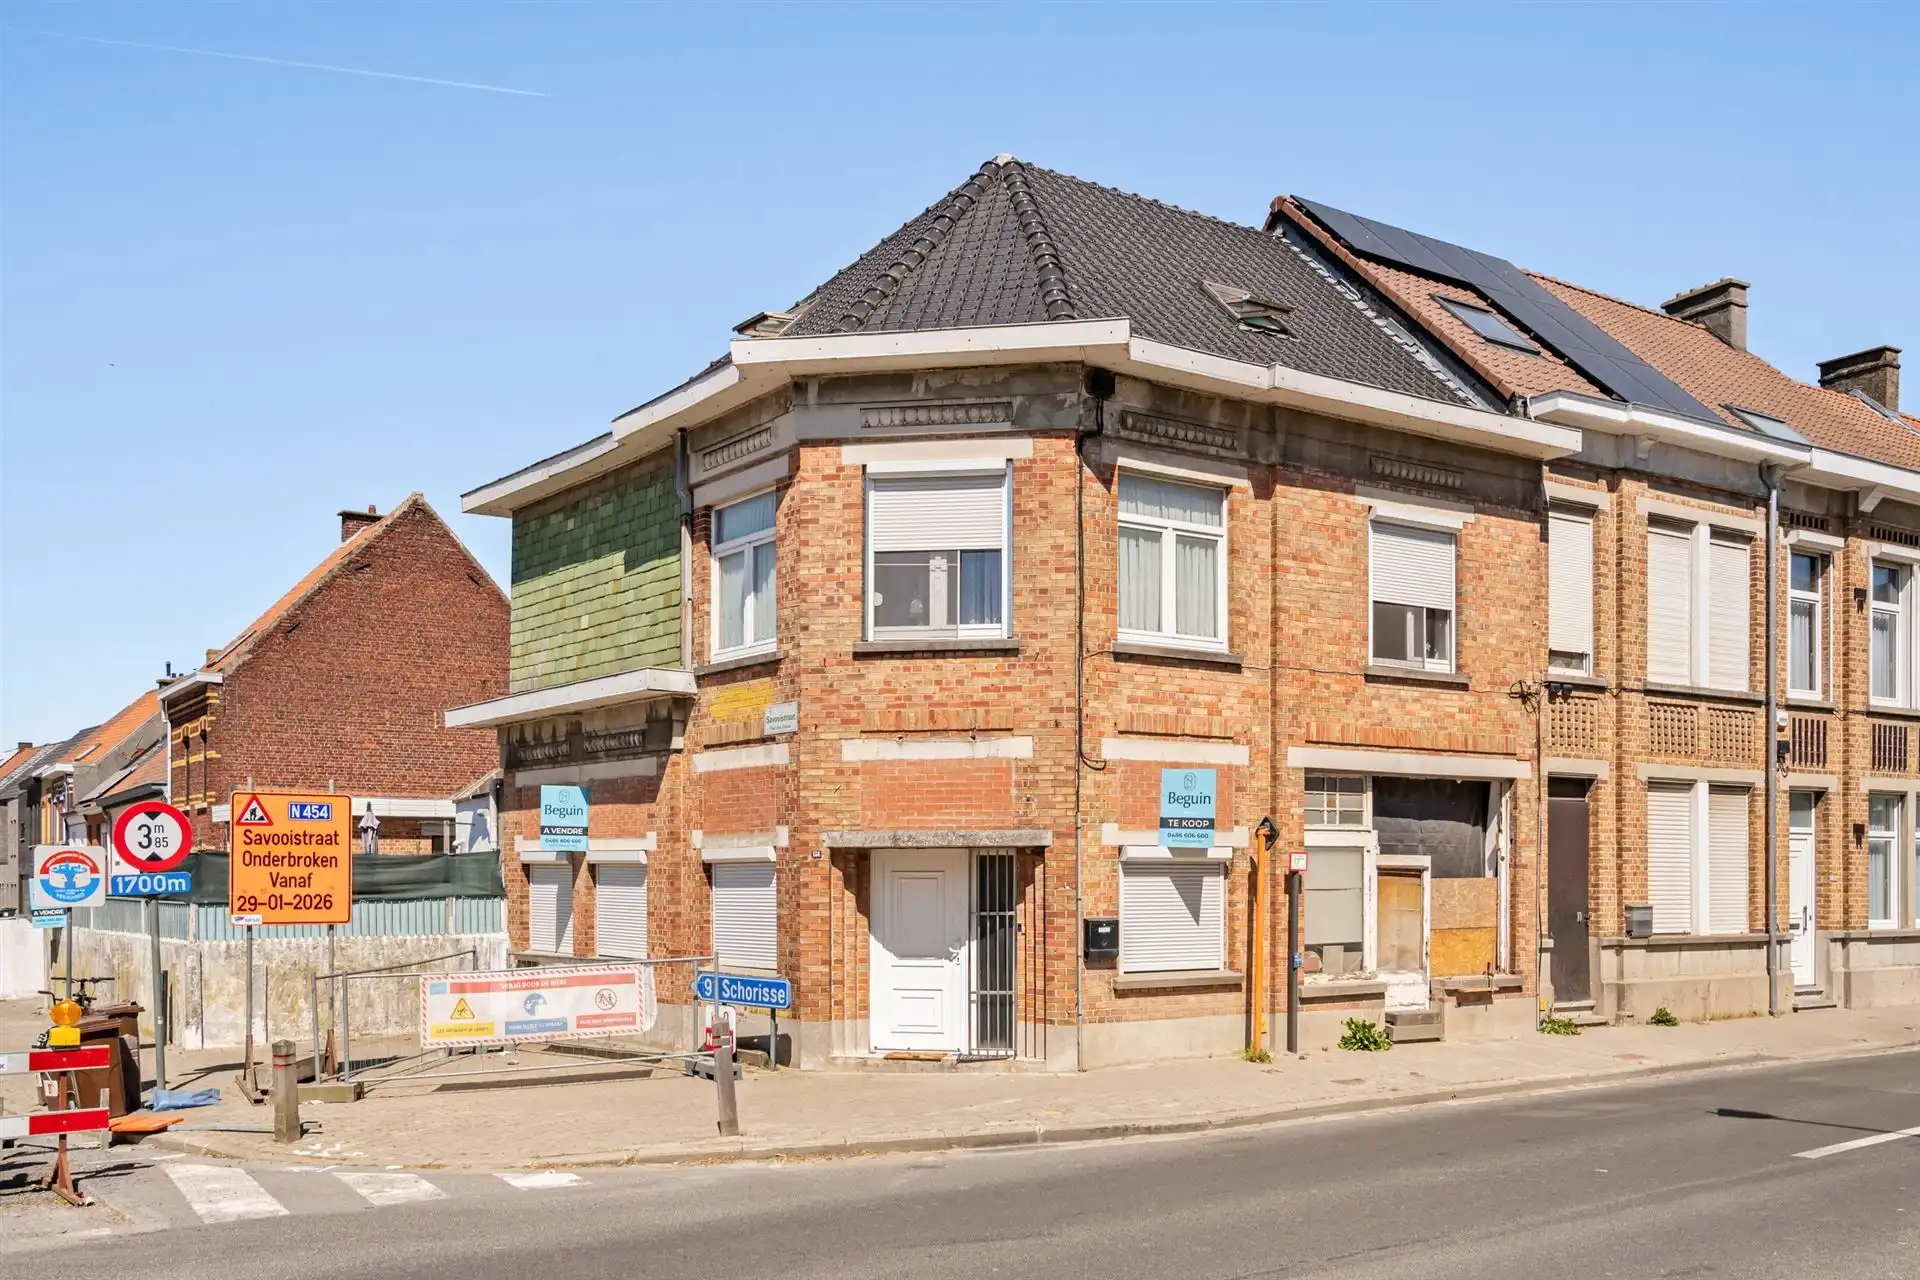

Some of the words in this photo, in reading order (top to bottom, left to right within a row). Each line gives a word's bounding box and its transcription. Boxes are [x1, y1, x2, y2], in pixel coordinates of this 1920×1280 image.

[1168, 791, 1211, 808] Beguin
[291, 805, 301, 818] N
[302, 805, 329, 819] 454
[544, 804, 584, 818] Beguin
[543, 827, 551, 835] A
[551, 827, 584, 835] VENDRE
[1168, 819, 1179, 827] TE
[1182, 819, 1209, 828] KOOP
[137, 823, 153, 850] 3
[154, 836, 169, 848] 85
[243, 828, 340, 846] Savooistraat
[242, 850, 338, 868] Onderbroken
[116, 874, 187, 894] 1700m
[269, 871, 314, 888] Vanaf
[236, 894, 334, 912] 29-01-2026
[40, 908, 64, 916] VENDRE
[704, 978, 713, 997] 9
[721, 978, 786, 1004] Schorisse
